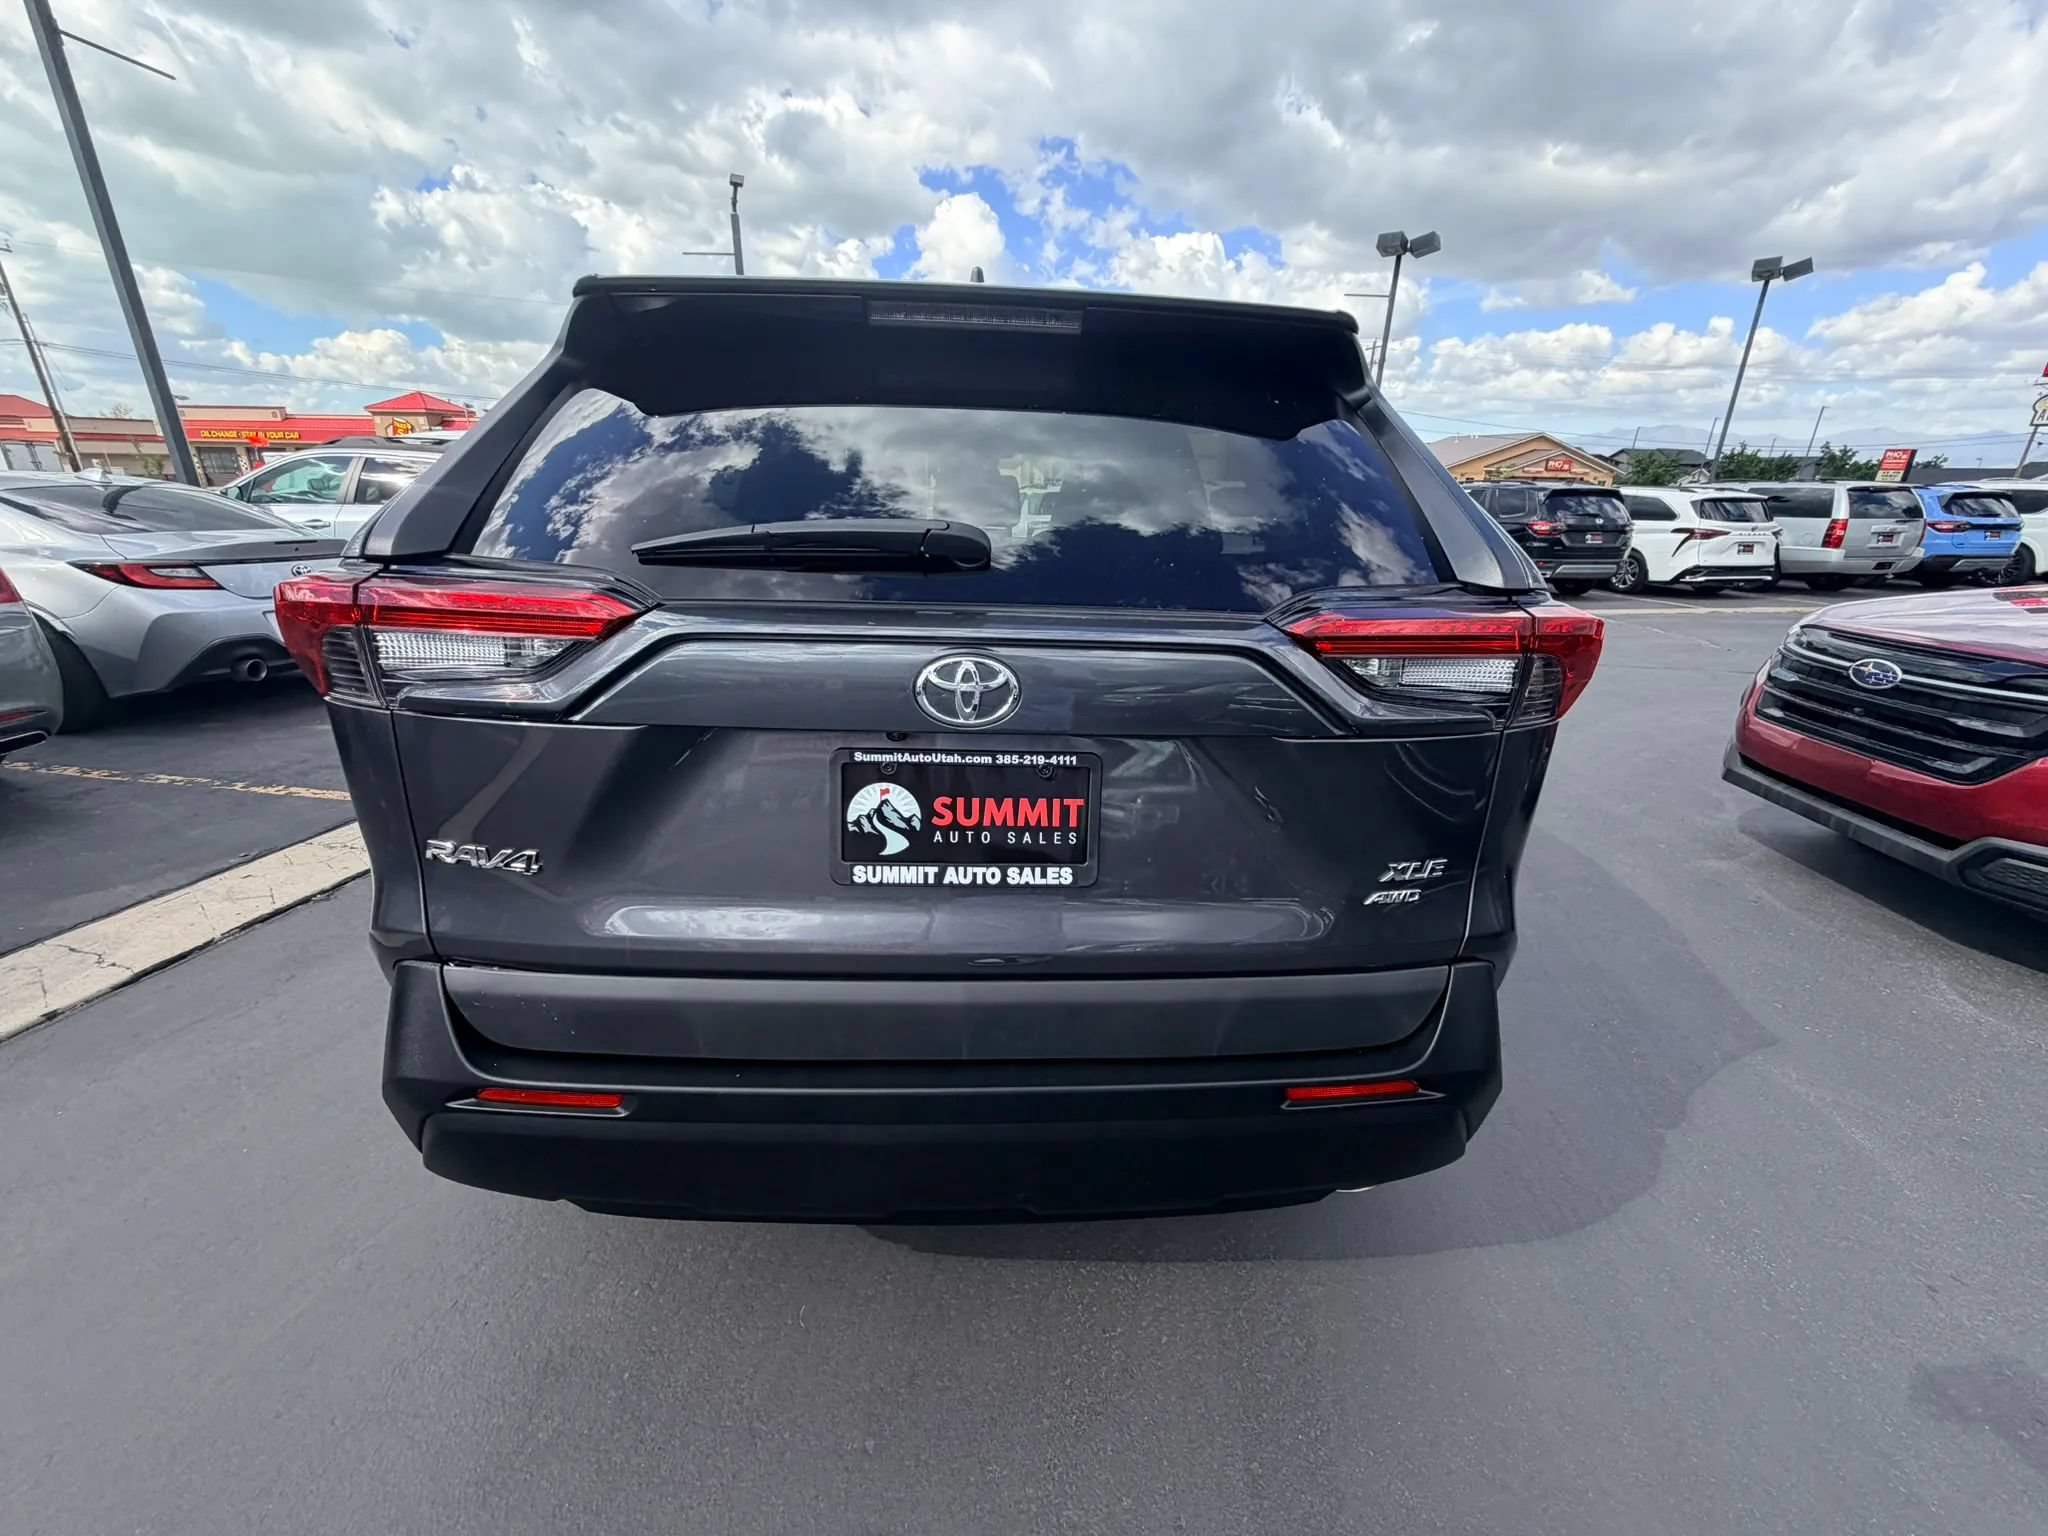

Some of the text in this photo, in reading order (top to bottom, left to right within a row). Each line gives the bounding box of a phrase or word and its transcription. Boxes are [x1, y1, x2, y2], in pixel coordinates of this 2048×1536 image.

[265, 431, 284, 440] YOUR
[285, 431, 300, 440] CAR
[853, 751, 1078, 766] SummitAutoUtah.com 385-219-4111
[931, 796, 1086, 828] SUMMIT
[933, 831, 1078, 845] AUTO SALES
[425, 839, 543, 876] RAV4
[852, 865, 1074, 885] SUMMIT AUTO SALES
[1378, 859, 1448, 883] XLE
[1363, 889, 1422, 905] AWD
